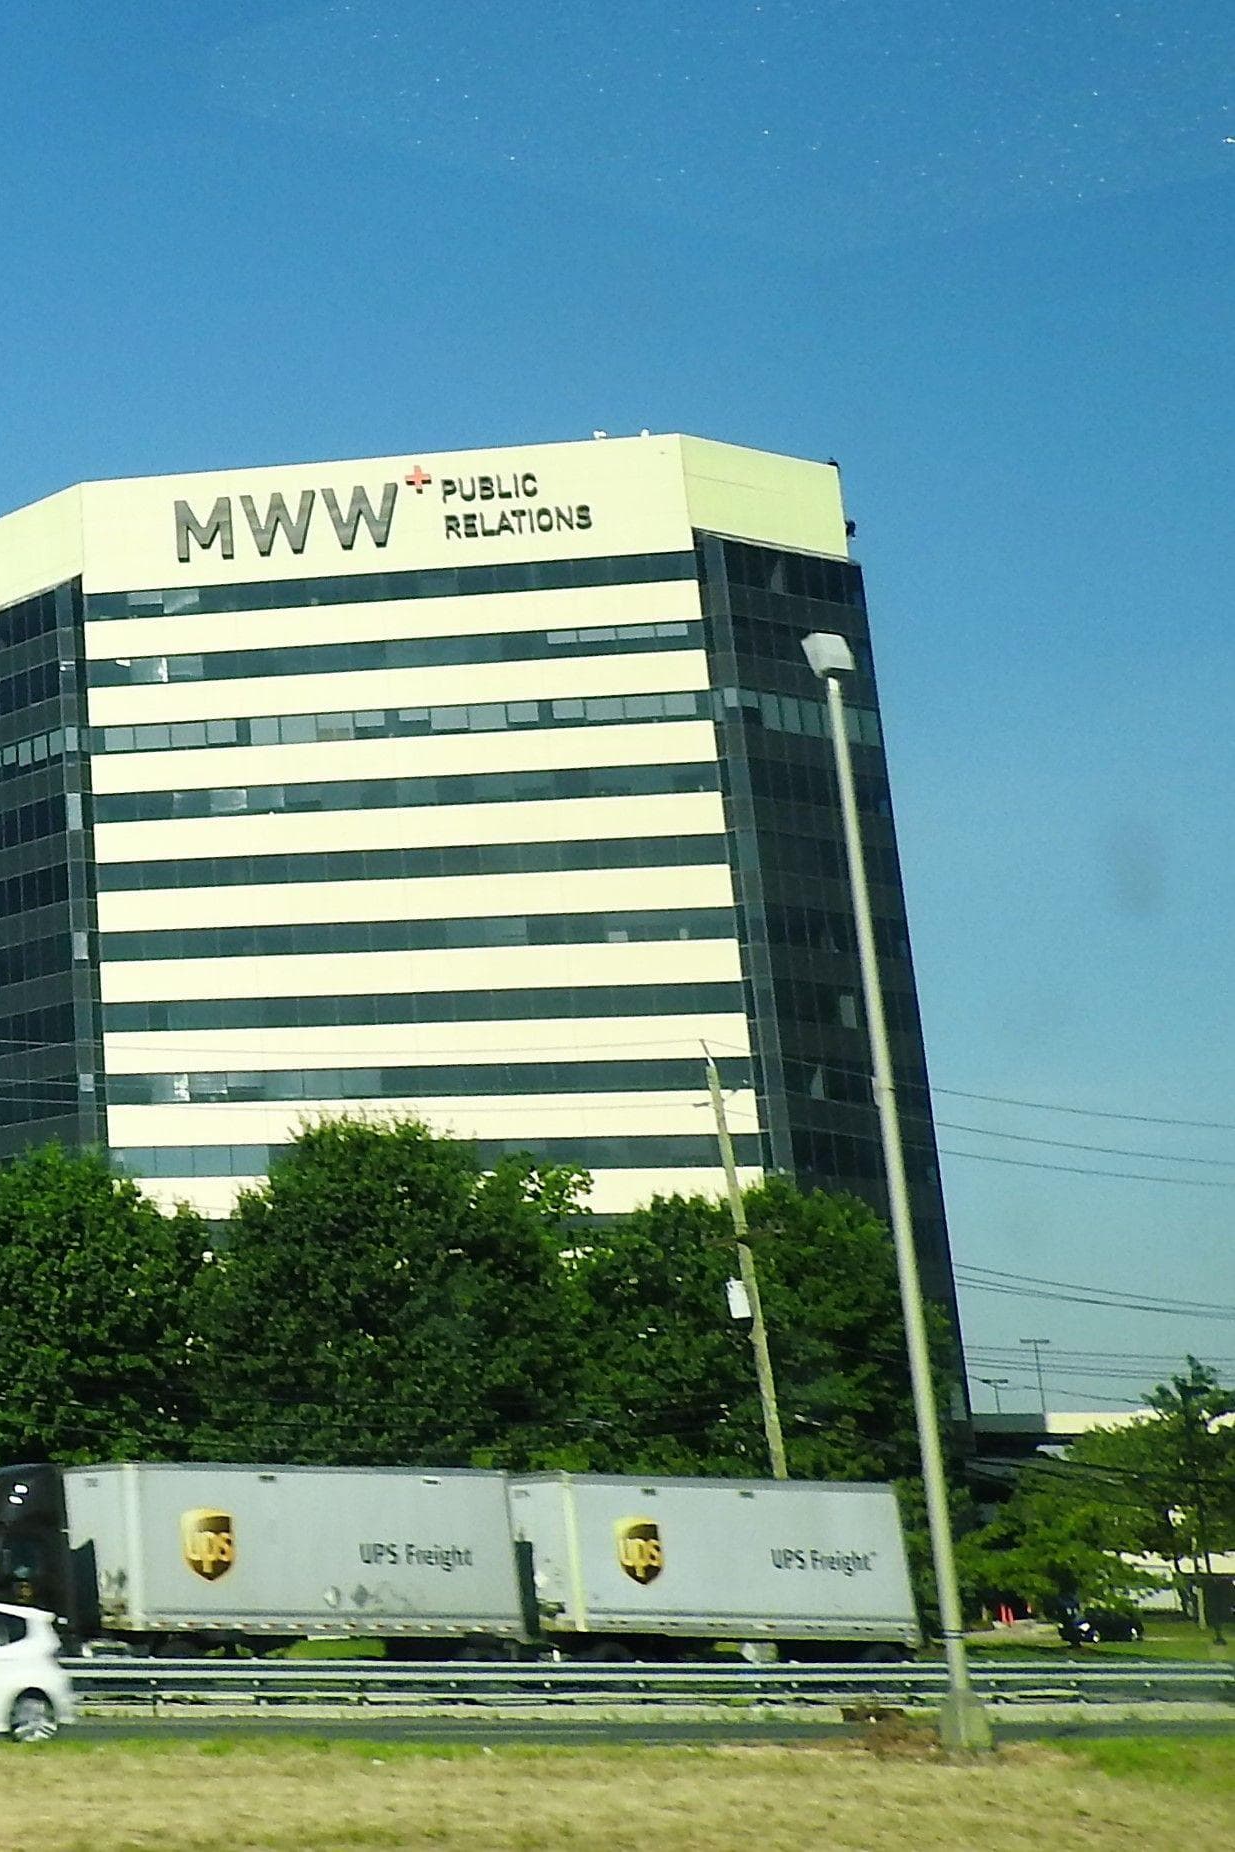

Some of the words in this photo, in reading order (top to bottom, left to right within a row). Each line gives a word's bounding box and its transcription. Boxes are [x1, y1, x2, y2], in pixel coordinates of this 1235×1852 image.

[441, 472, 538, 504] PUBLIC
[174, 482, 398, 563] MWW
[444, 504, 593, 540] RELATIONS
[359, 1542, 398, 1565] UPS
[405, 1542, 473, 1573] Freight
[770, 1547, 805, 1570] UPS
[809, 1548, 873, 1577] Freight
